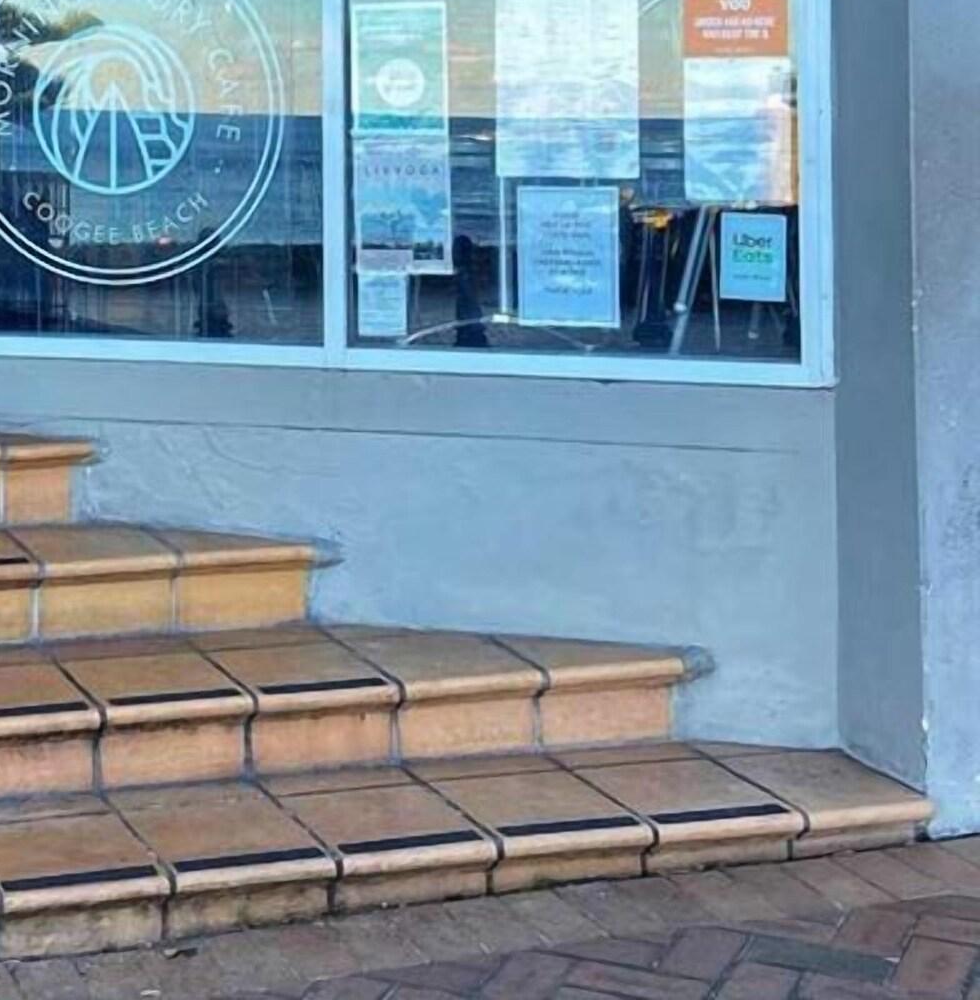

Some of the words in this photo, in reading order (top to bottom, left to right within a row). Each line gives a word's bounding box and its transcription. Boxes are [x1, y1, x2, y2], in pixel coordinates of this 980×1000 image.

[207, 47, 244, 142] CAFE
[22, 191, 123, 246] COOGEE
[131, 191, 209, 244] BEACH
[731, 232, 773, 249] Uber
